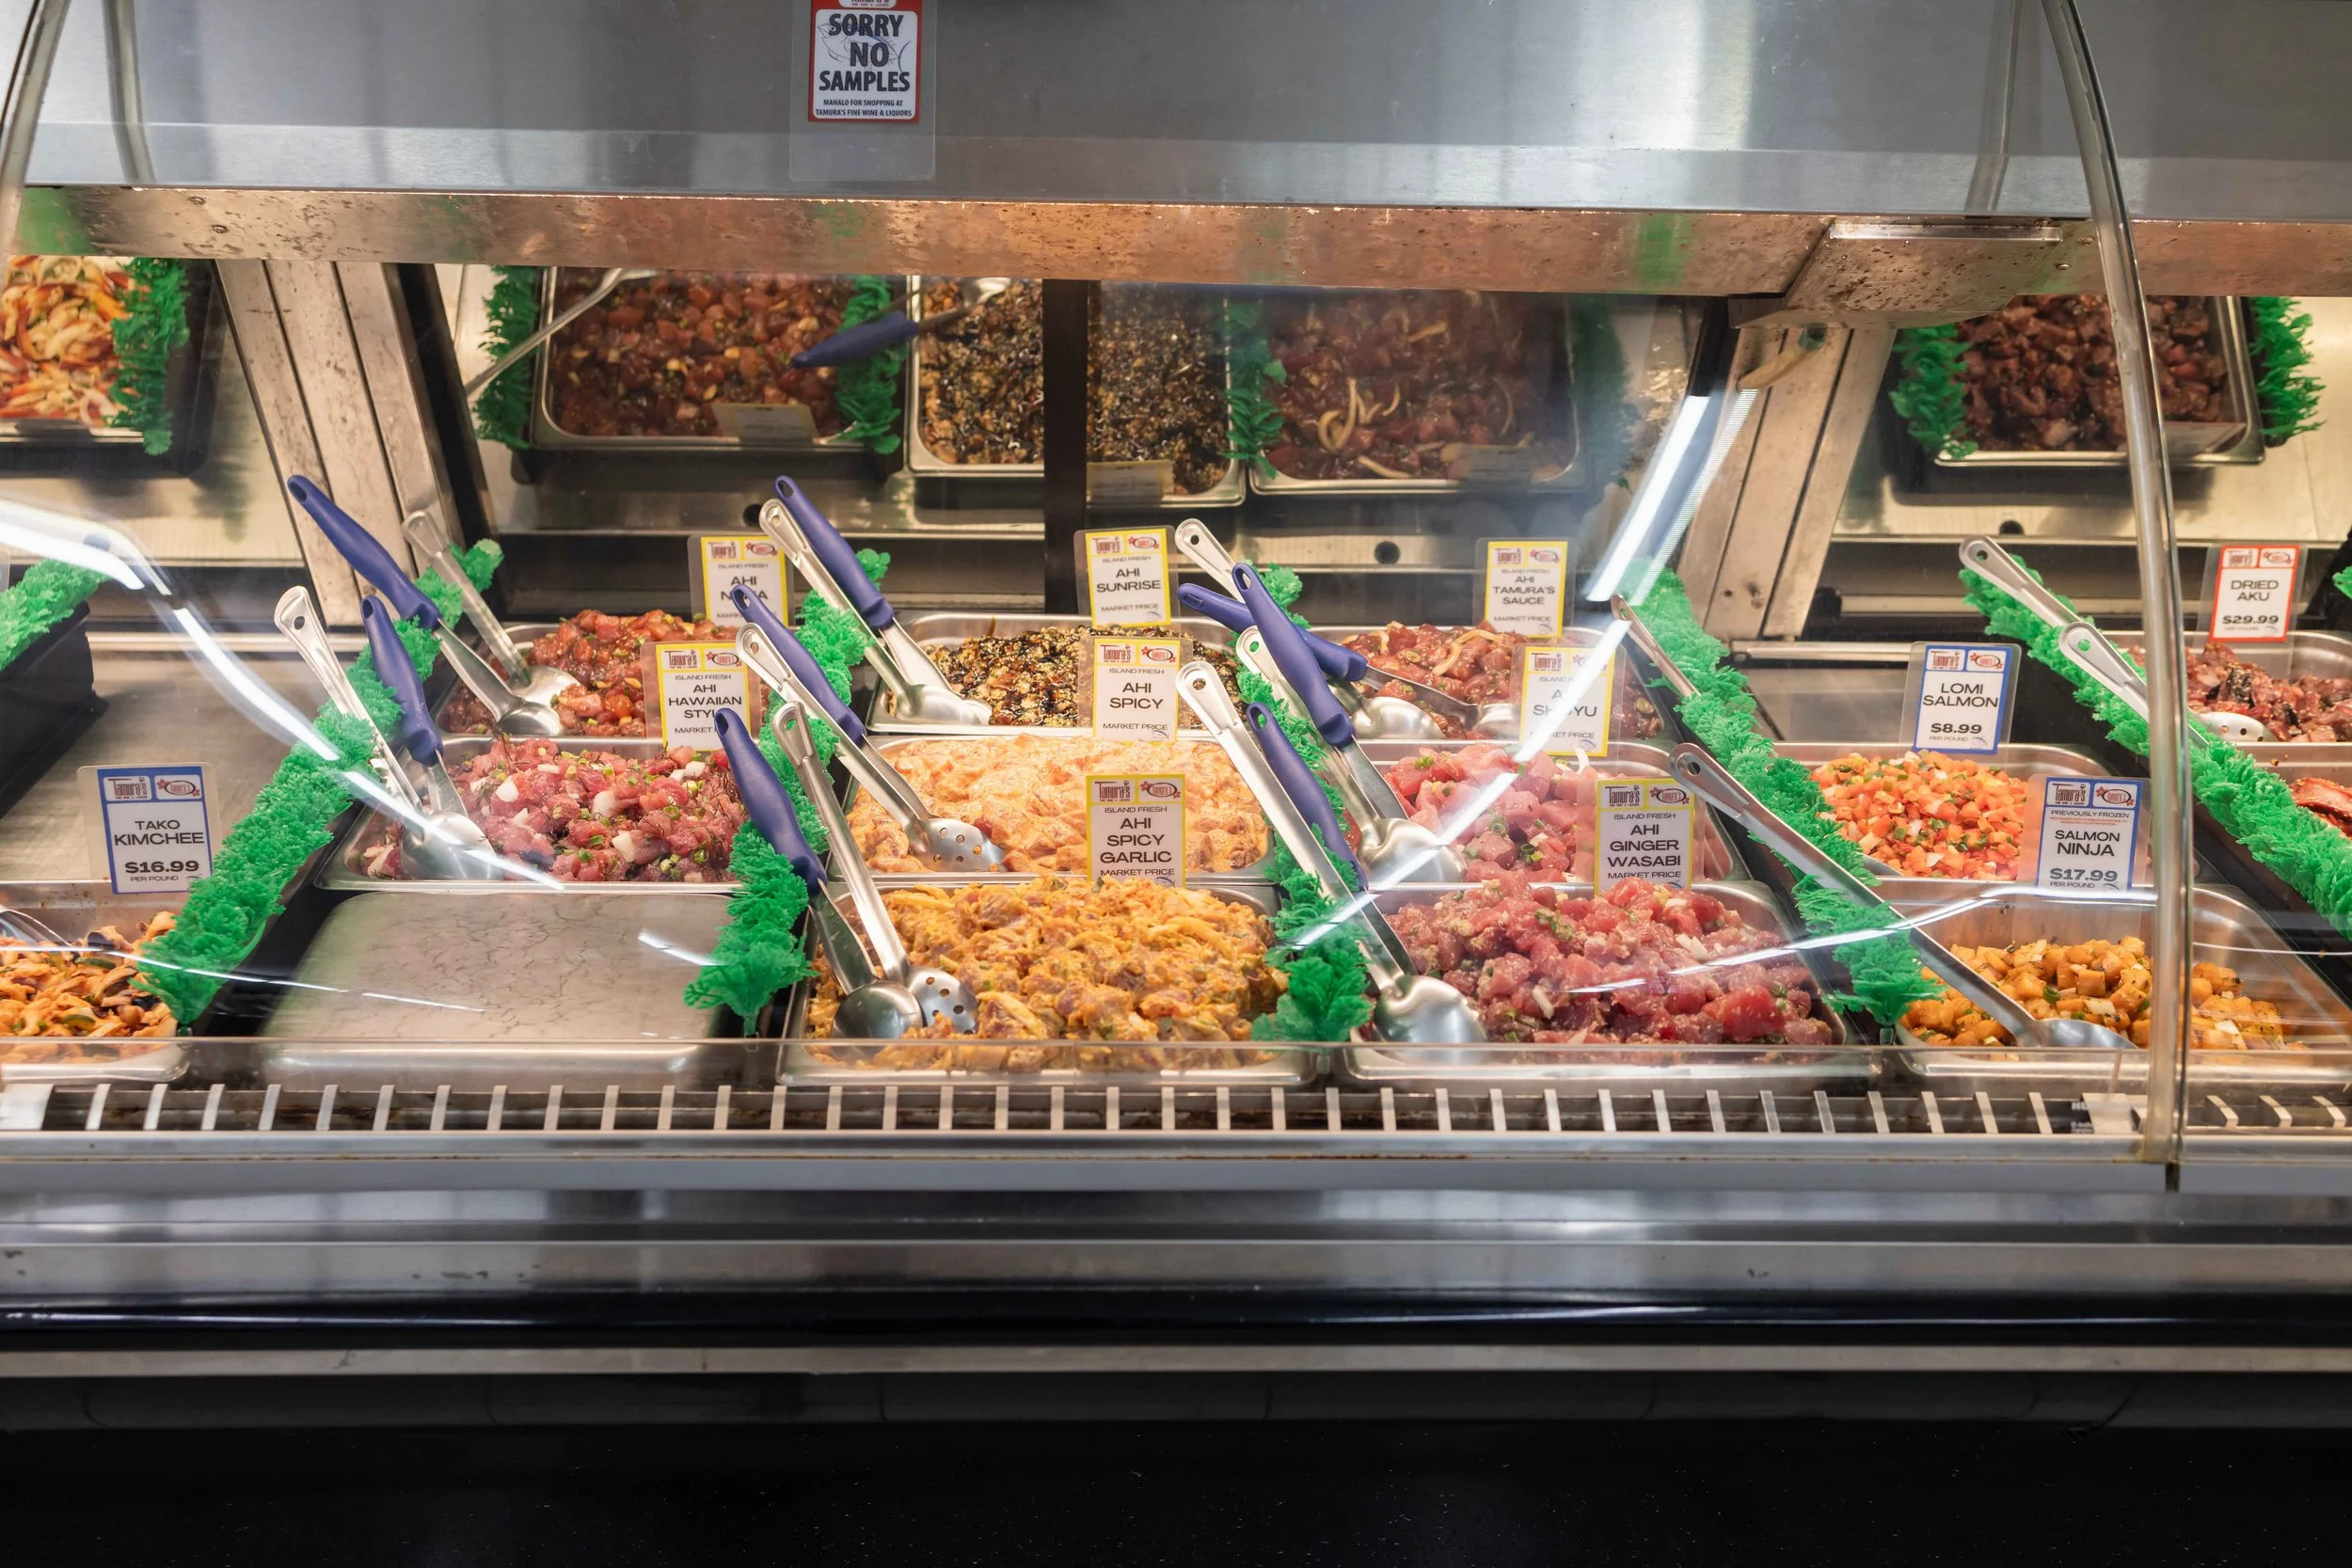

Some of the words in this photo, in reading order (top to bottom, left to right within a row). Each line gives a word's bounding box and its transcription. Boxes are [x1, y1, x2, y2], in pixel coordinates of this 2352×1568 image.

[828, 13, 904, 37] SORRY
[850, 42, 890, 67] NO
[818, 71, 911, 92] SAMPLES
[1116, 568, 1140, 578] AHI
[731, 576, 756, 585] AHI
[1097, 579, 1161, 593] SUNRISE
[2231, 579, 2279, 590] DRIED
[721, 591, 768, 600] NA
[1493, 586, 1555, 594] TAMURA'S
[2237, 593, 2269, 601] AKU
[2222, 615, 2279, 624] $29.99
[1122, 683, 1152, 693] AHI
[1941, 683, 1983, 694] LOMI
[669, 697, 742, 705] HAWAIIAN
[1110, 698, 1164, 709] SPICY
[1923, 695, 1998, 707] SALMON
[1931, 723, 1981, 734] $8.99
[135, 820, 180, 830] TAKO
[1120, 817, 1151, 829] AHI
[1630, 825, 1659, 835] AHI
[114, 832, 204, 846] KIMCHEE
[1107, 834, 1165, 847] SPICY
[2055, 830, 2120, 842] SALMON
[1610, 840, 1679, 851] GINGER
[2058, 843, 2115, 856] NINJA
[1100, 851, 1172, 863] GARLIC
[1607, 856, 1680, 867] WASABI
[125, 861, 199, 873] $16.99
[2050, 868, 2118, 881] $17.99
